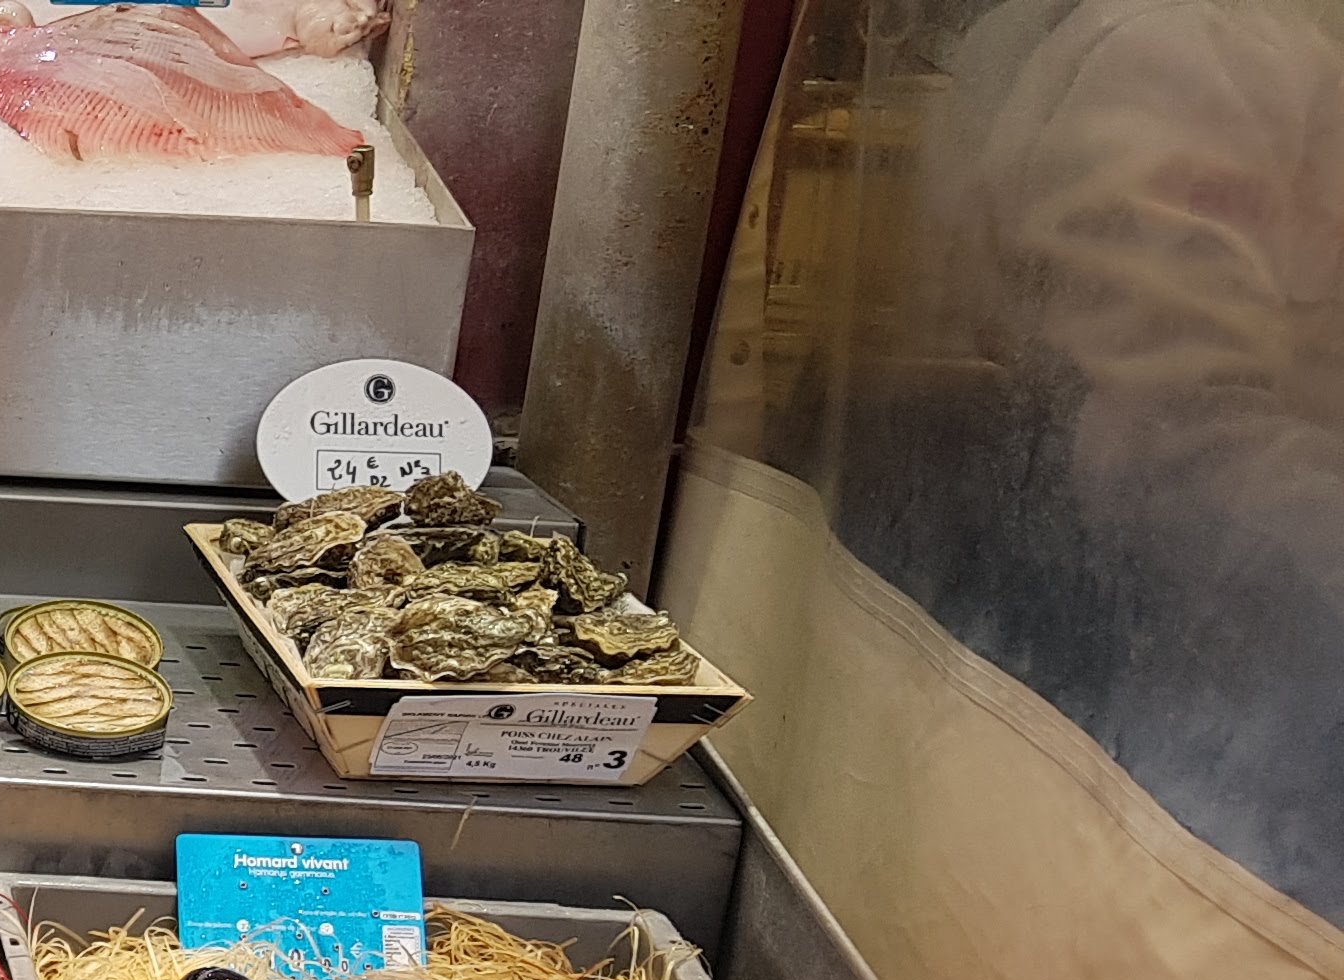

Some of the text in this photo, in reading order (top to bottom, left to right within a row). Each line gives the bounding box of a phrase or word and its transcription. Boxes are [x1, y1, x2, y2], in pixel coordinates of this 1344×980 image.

[309, 410, 446, 438] Gillardeau
[326, 459, 357, 484] 24
[520, 708, 640, 727] Gillardeau
[559, 753, 583, 763] 48
[603, 750, 628, 769] 3
[233, 853, 350, 870] Homard vivant
